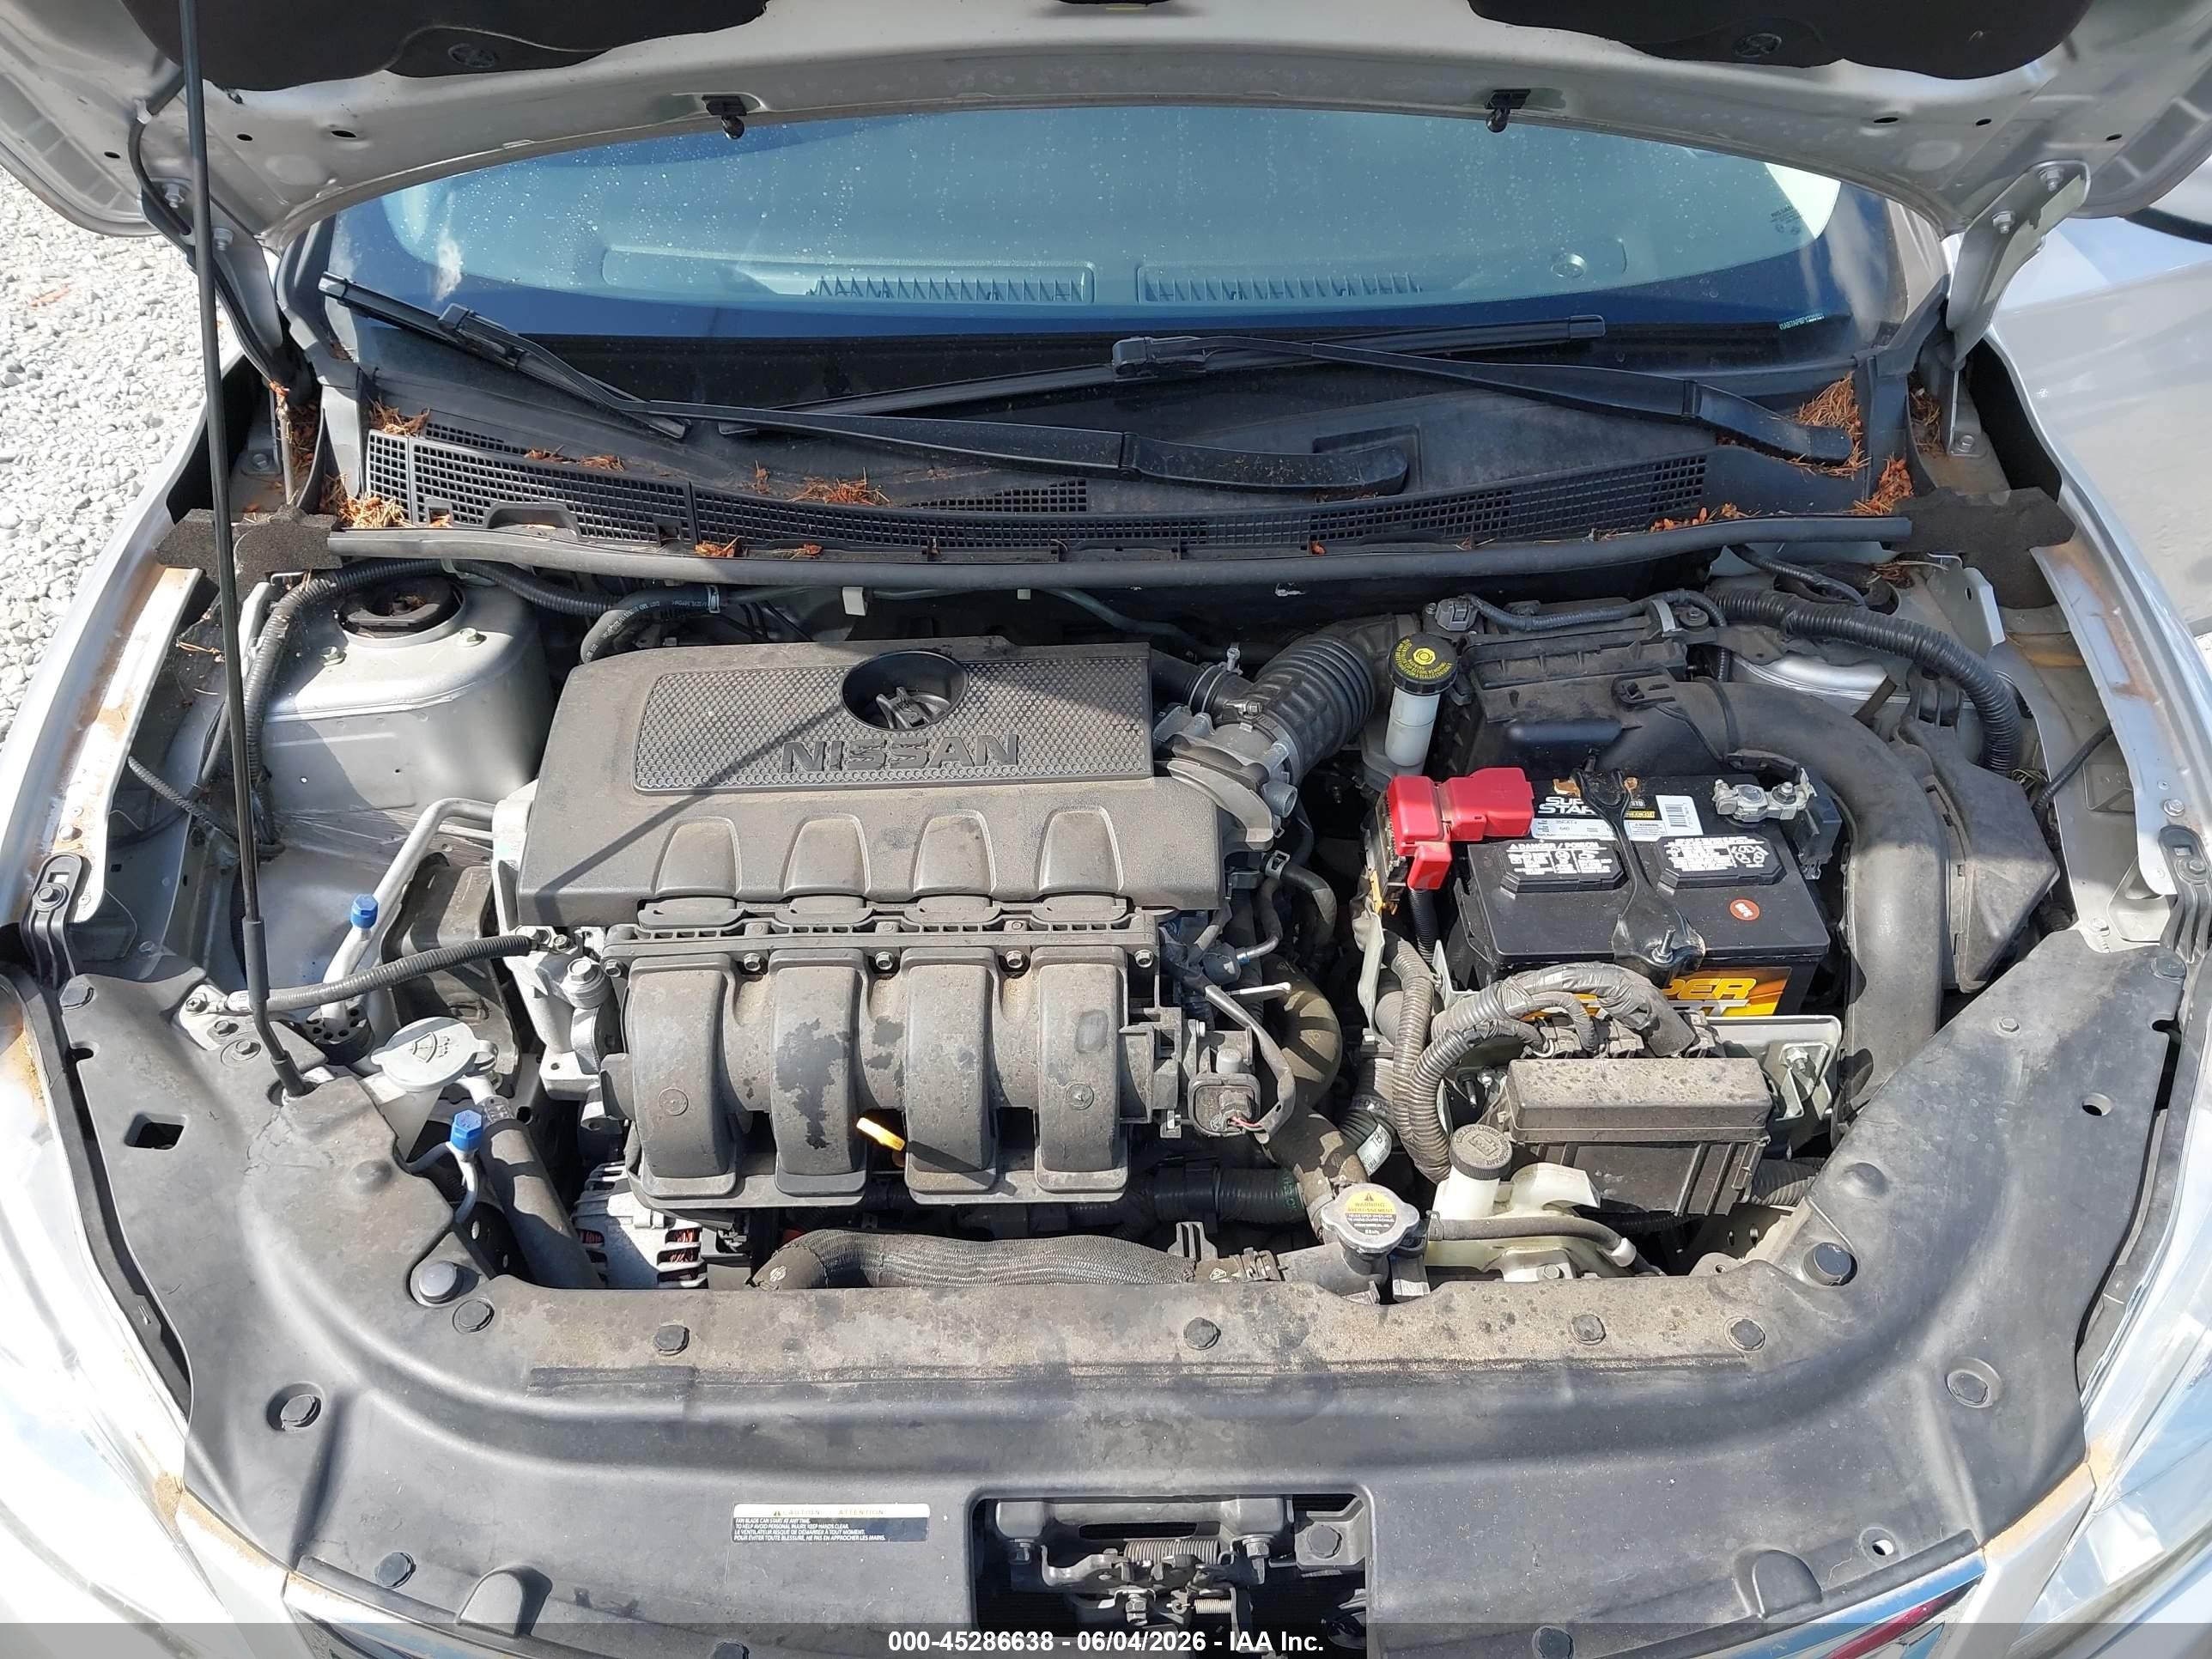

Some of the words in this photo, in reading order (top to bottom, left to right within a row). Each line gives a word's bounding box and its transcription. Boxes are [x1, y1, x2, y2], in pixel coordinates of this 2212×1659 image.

[781, 733, 1019, 773] NISSAN
[1545, 796, 1585, 805] SUP
[1538, 805, 1596, 814] STAR
